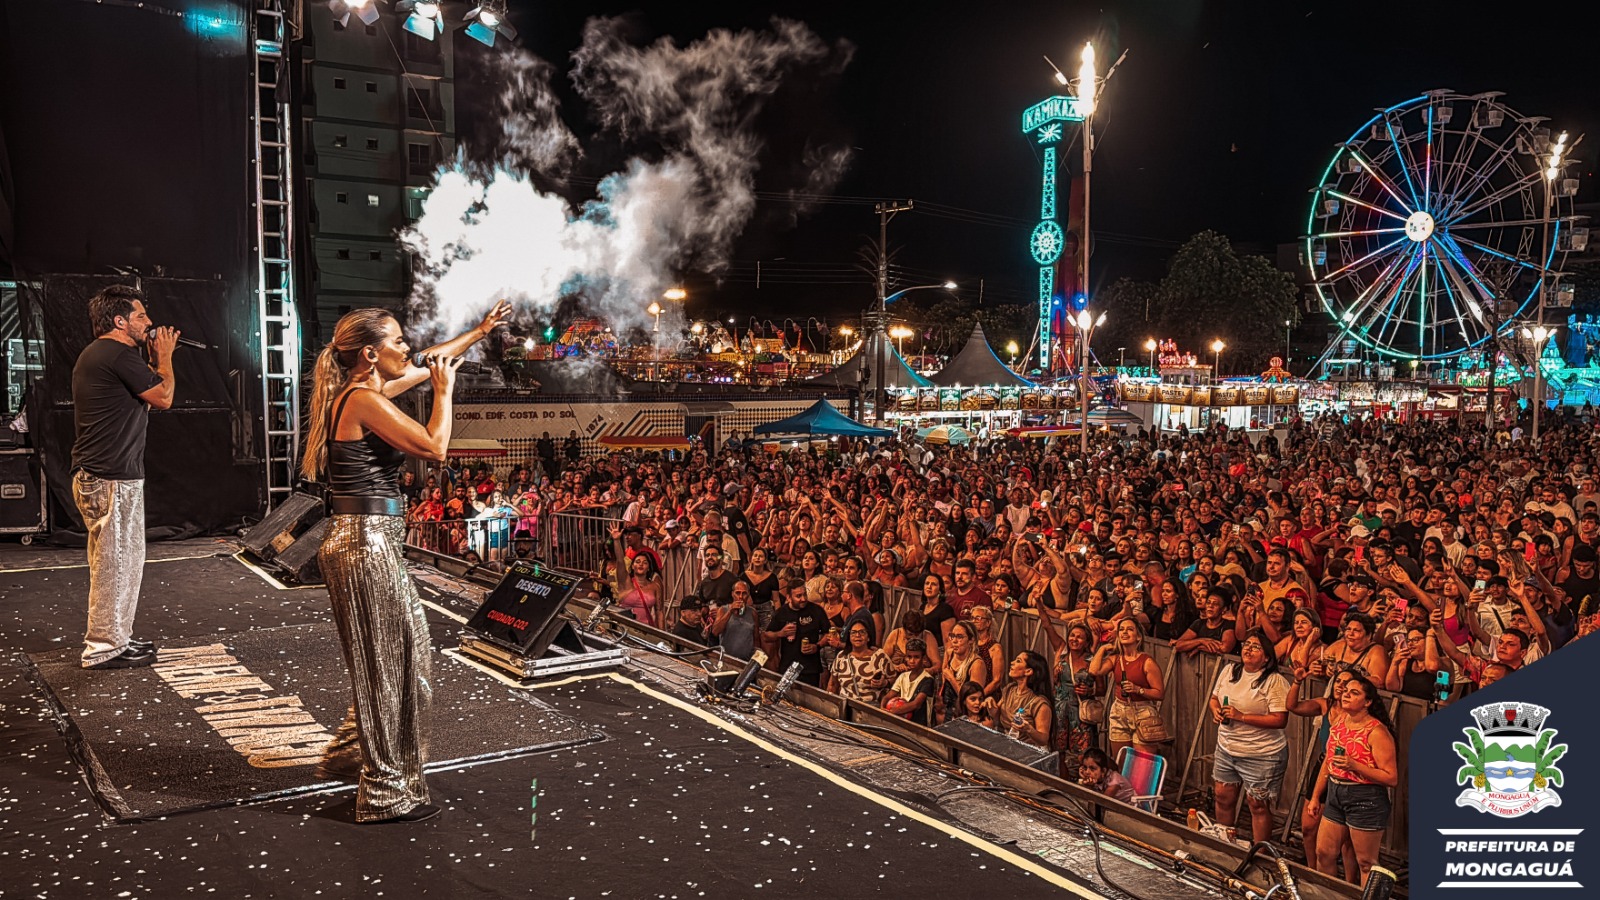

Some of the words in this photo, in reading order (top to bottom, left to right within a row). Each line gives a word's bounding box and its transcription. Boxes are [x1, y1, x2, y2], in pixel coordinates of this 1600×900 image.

[1162, 389, 1185, 397] PASTEL
[455, 412, 483, 420] COND.
[486, 411, 506, 420] EDIF.
[510, 411, 538, 419] COSTA
[543, 411, 555, 419] DO
[560, 410, 576, 419] SOL
[586, 414, 604, 434] 1874
[515, 578, 552, 597] DESERTO
[519, 594, 528, 604] D
[487, 609, 516, 626] CUIDADO
[513, 619, 529, 631] CO2
